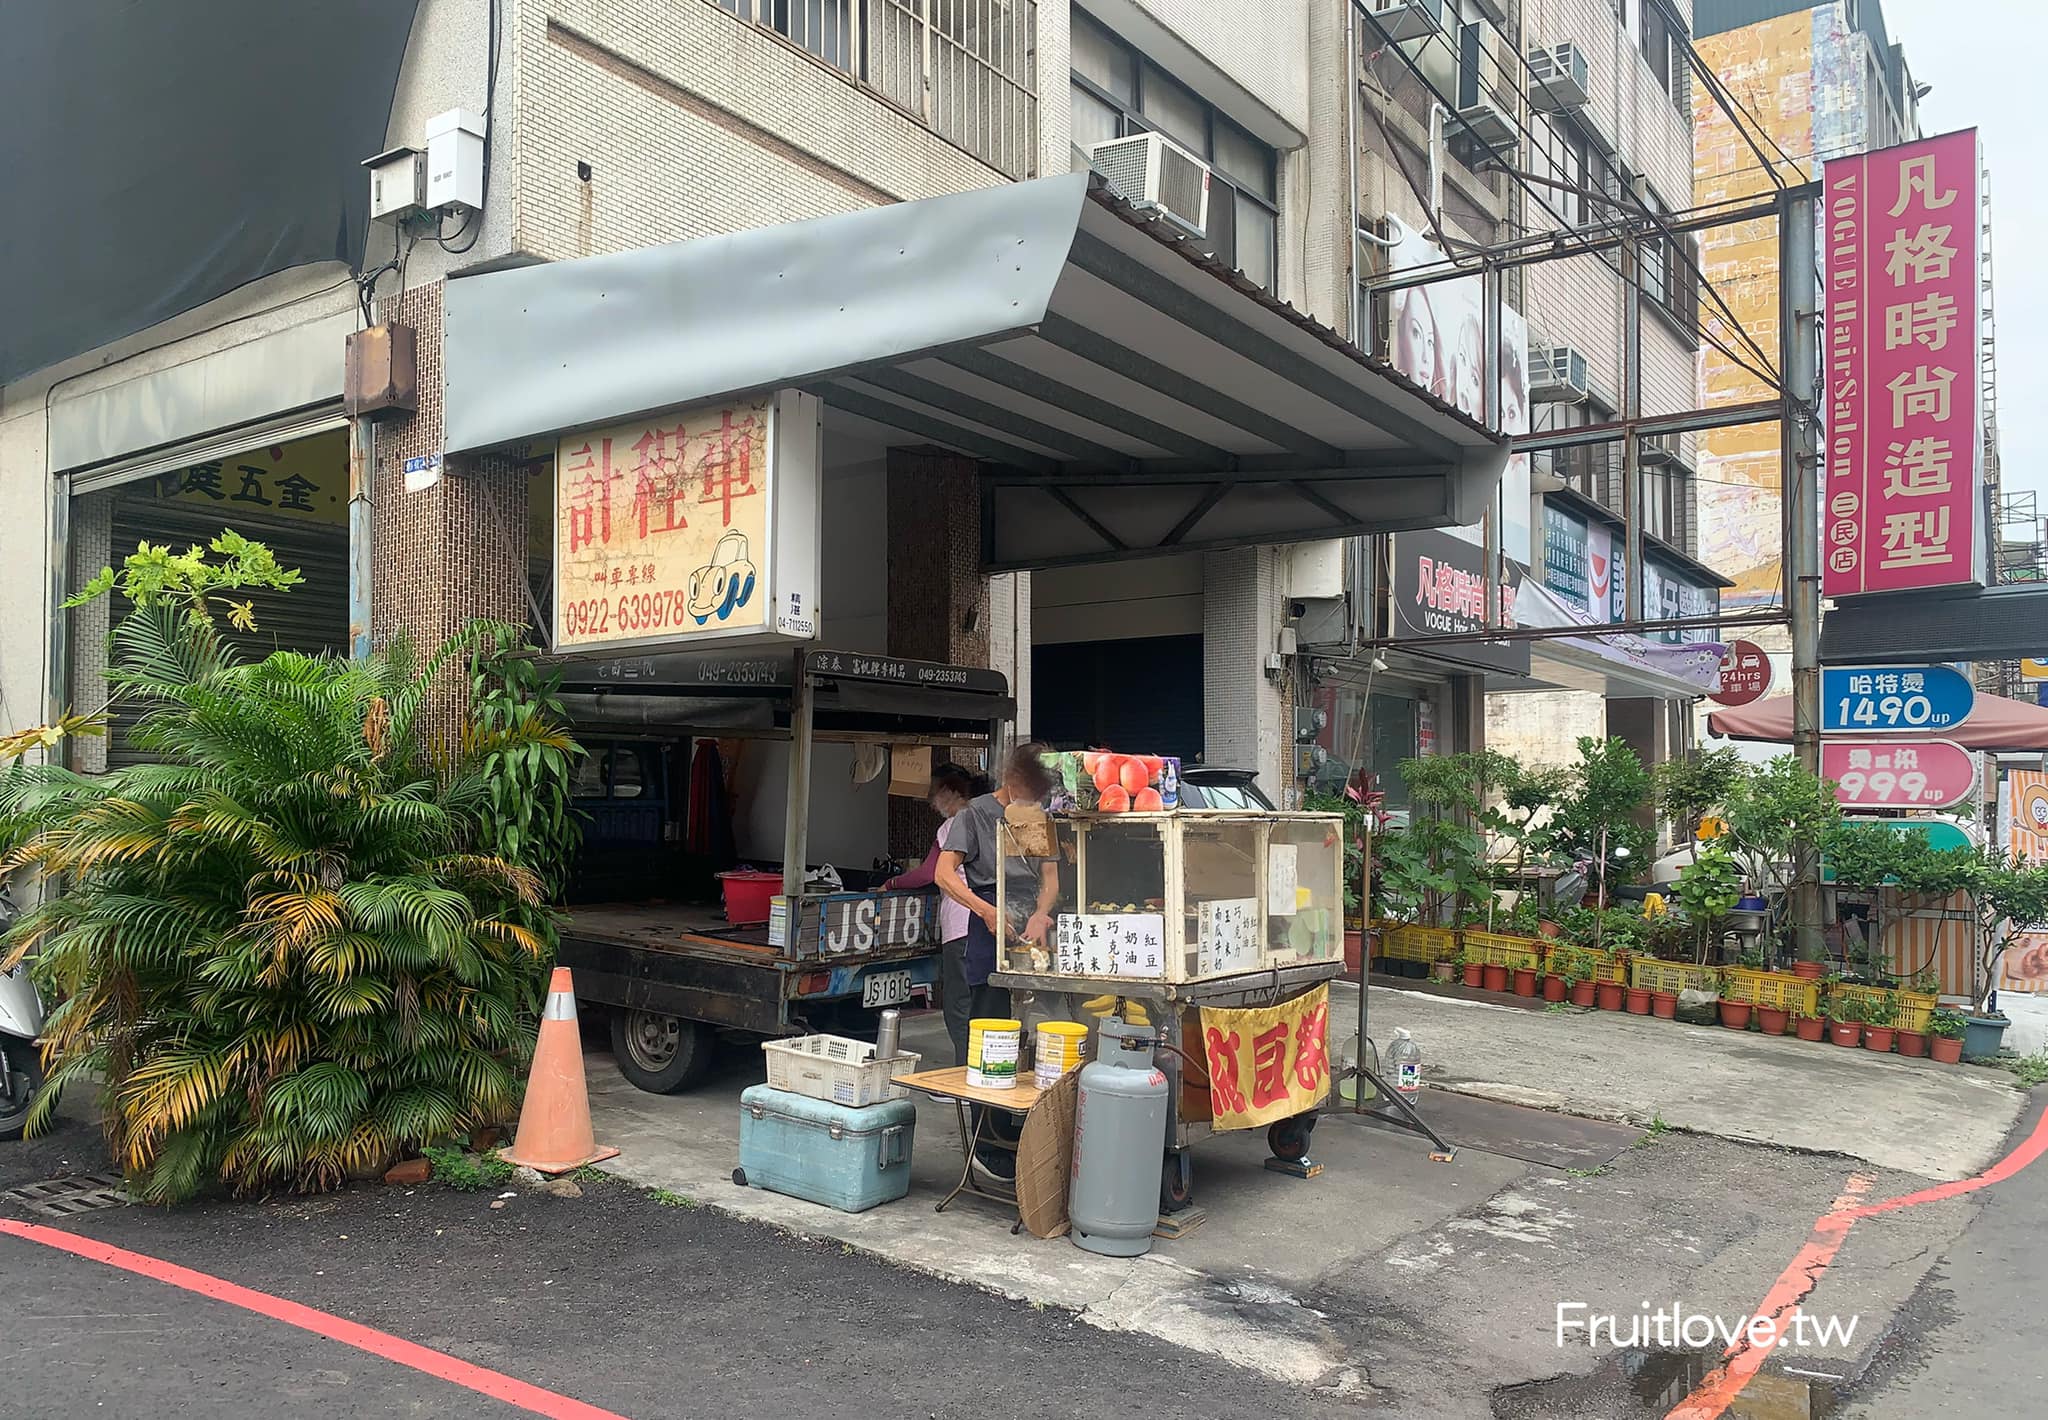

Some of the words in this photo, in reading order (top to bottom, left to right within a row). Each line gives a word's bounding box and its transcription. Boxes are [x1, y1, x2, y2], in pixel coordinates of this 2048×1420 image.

[1832, 175, 1857, 289] VOGUE
[1880, 154, 1959, 569] 凡格時尚造型
[567, 410, 757, 553] 計程車
[1832, 493, 1857, 572] 三民店
[594, 563, 656, 592] 叫車專線
[1416, 556, 1518, 629] 凡格時尚型
[566, 590, 684, 636] 0922-639978
[1425, 611, 1452, 632] VOGUE
[918, 668, 967, 684] 049-2353743
[1720, 682, 1761, 693] 車場
[1722, 672, 1761, 683] 24hrs
[1849, 673, 1925, 694] 哈特燙
[1058, 914, 1071, 972] 每個五元
[1072, 916, 1085, 974] 南瓜牛奶
[1089, 924, 1101, 972] 玉米
[1107, 920, 1120, 975] 巧克力
[1124, 930, 1138, 965] 奶油
[1144, 933, 1158, 968] 紅豆
